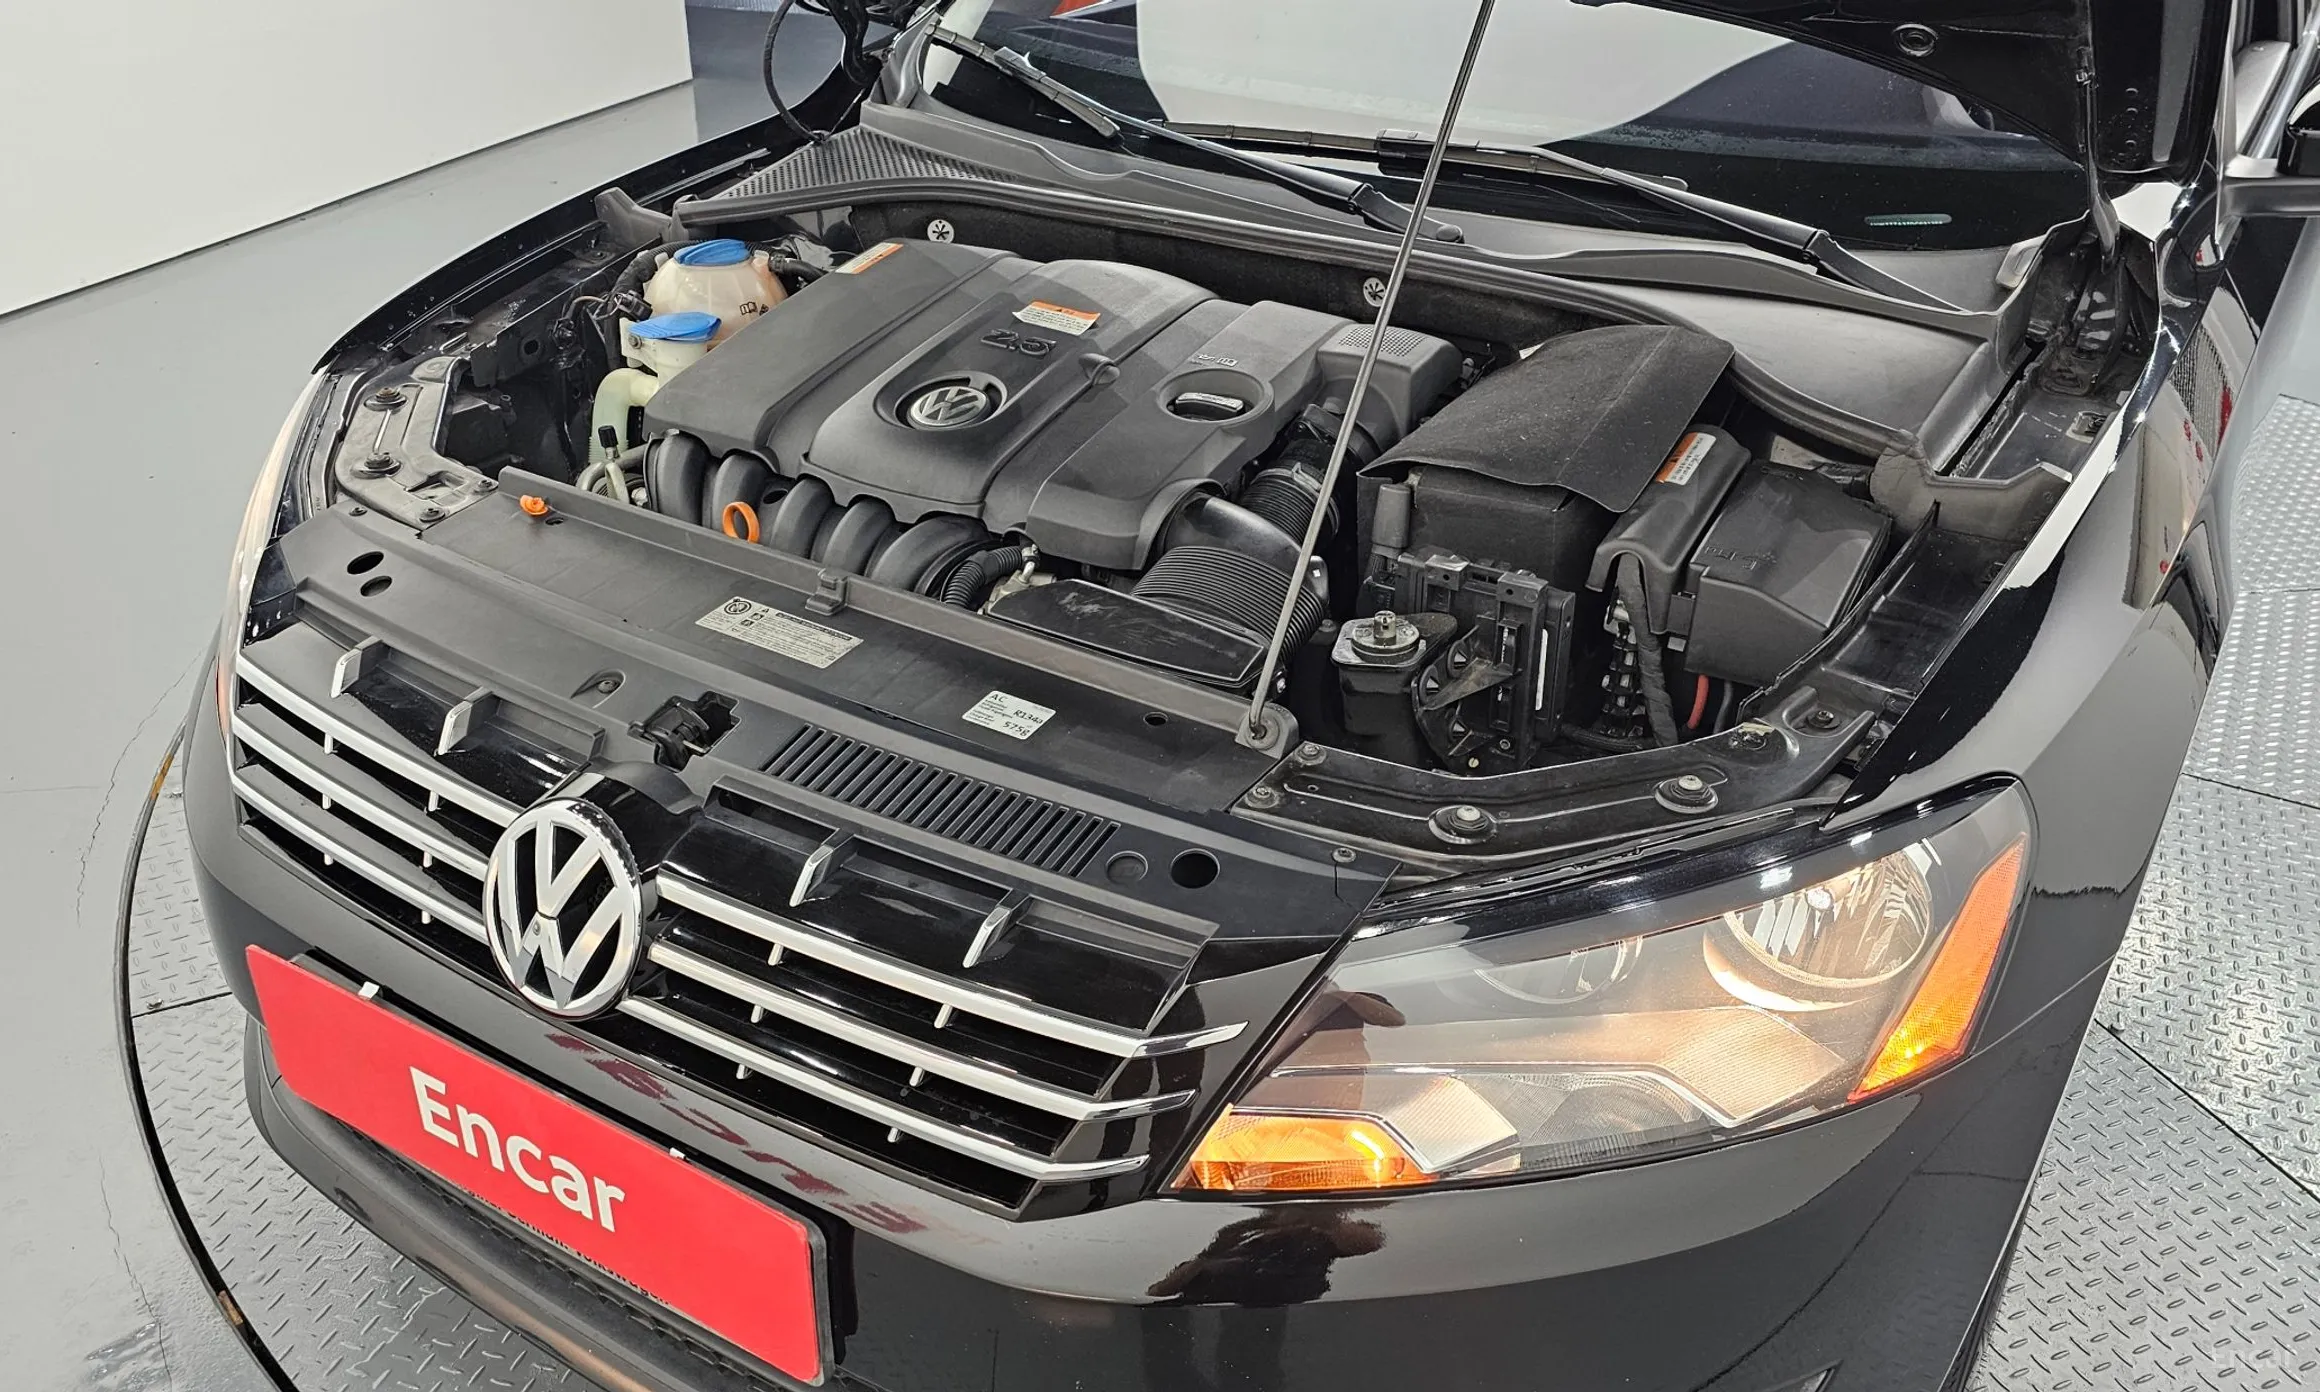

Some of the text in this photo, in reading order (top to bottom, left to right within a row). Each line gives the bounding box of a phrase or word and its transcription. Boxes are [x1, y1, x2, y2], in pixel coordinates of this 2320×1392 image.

[980, 328, 1057, 356] 2.5
[911, 386, 987, 426] VW
[488, 803, 640, 1016] VW
[409, 1066, 626, 1233] Encar
